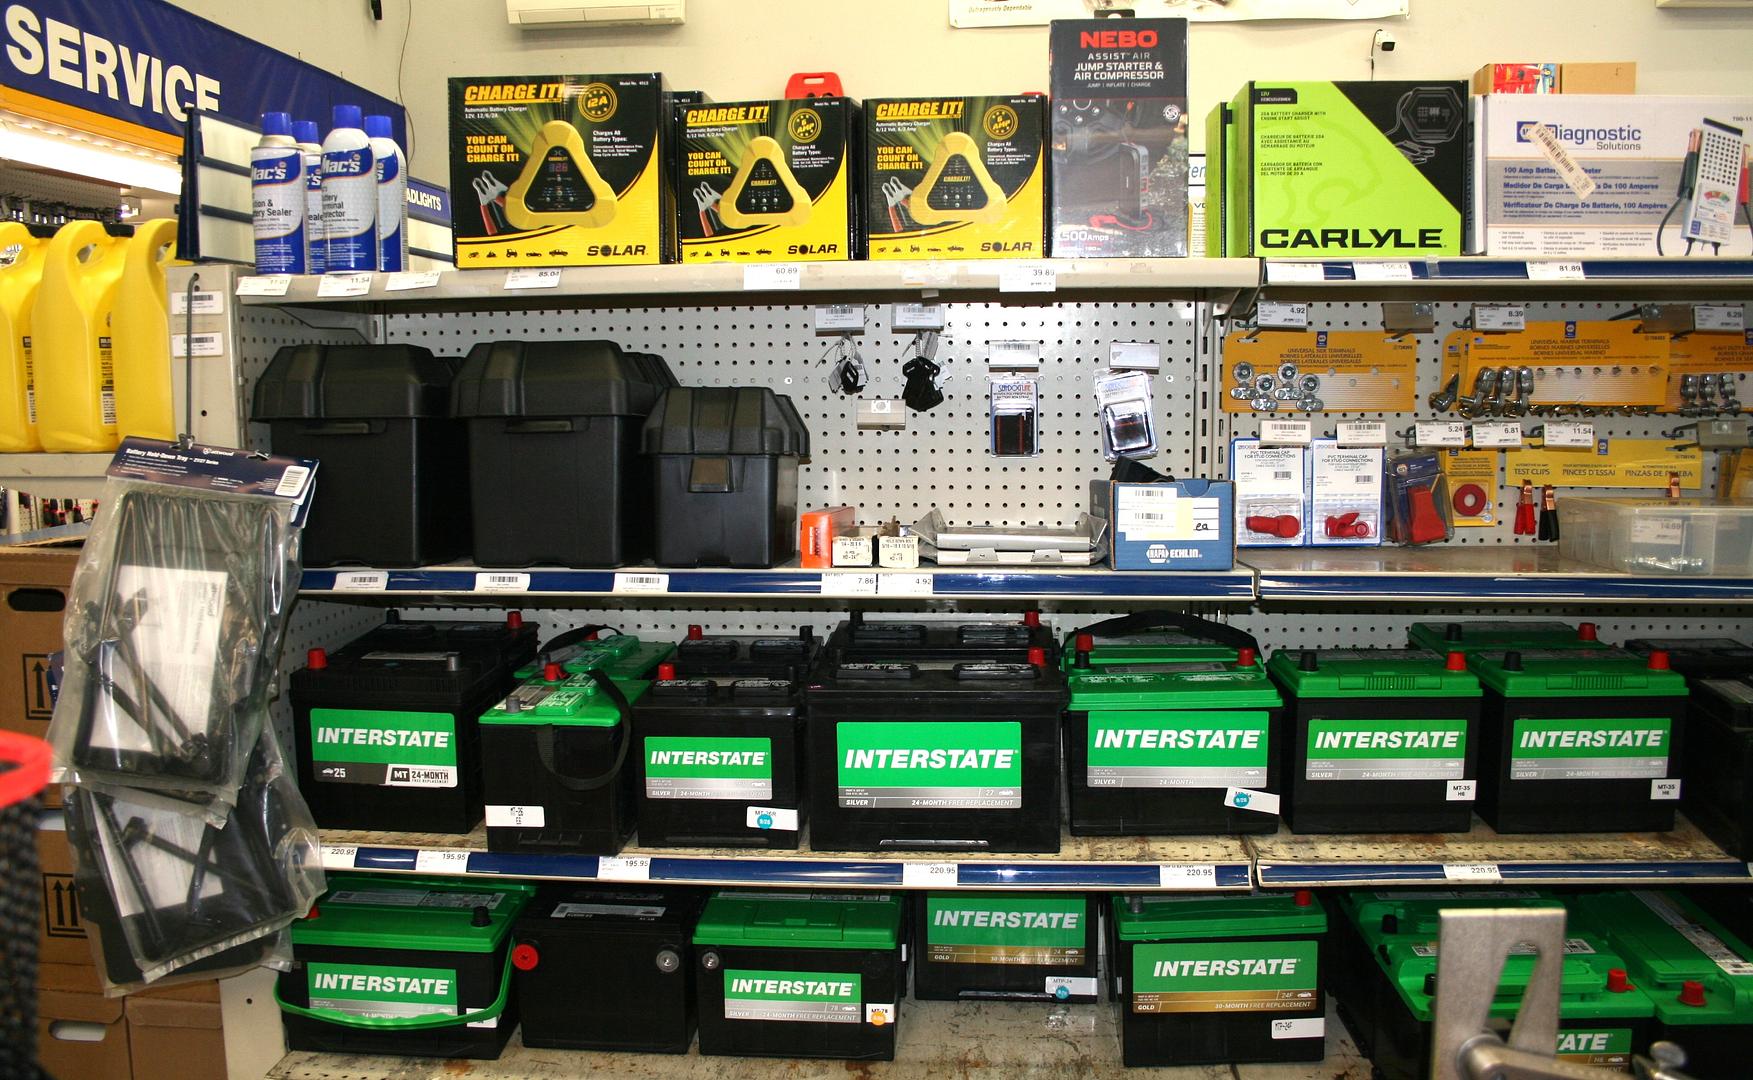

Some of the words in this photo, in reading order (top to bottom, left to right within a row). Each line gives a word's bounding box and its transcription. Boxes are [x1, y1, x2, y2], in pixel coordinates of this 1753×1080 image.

[1080, 29, 1158, 49] NEBO
[1132, 52, 1151, 60] AIR
[5, 4, 221, 123] SERVICE
[1075, 62, 1104, 72] JUMP
[1105, 61, 1153, 71] STARTER
[1154, 61, 1164, 71] &
[1073, 71, 1092, 81] AIR
[1093, 70, 1165, 80] COMPRESSOR
[464, 84, 538, 101] CHARGE
[540, 83, 566, 99] IT!
[687, 107, 747, 123] CHARGE
[748, 105, 770, 120] IT!
[876, 102, 940, 117] CHARGE
[941, 101, 964, 115] IT!
[465, 135, 486, 145] YOU
[487, 134, 507, 144] CAN
[466, 144, 499, 154] COUNT
[500, 144, 515, 153] ON
[877, 146, 894, 154] YOU
[895, 146, 913, 154] CAN
[1596, 142, 1642, 151] Solutions
[466, 153, 505, 163] CHARGE
[506, 153, 520, 163] IT!
[688, 152, 704, 160] YOU
[705, 151, 721, 159] CAN
[877, 154, 906, 162] COUNT
[906, 154, 919, 162] ON
[688, 159, 715, 168] COUNT
[715, 159, 727, 167] ON
[877, 162, 911, 170] CHARGE
[911, 162, 923, 170] IT!
[688, 168, 720, 176] CHARGE
[720, 166, 731, 175] IT!
[1518, 167, 1534, 175] Amp
[1503, 182, 1530, 190] Medidor
[1532, 182, 1542, 190] De
[1545, 182, 1564, 191] Carga
[1630, 182, 1659, 191] Amperes
[267, 199, 274, 207] &
[1555, 202, 1579, 211] Charge
[267, 208, 293, 217] Sealer
[1260, 229, 1443, 249] CARLYLE
[586, 244, 649, 258] SOLAR
[787, 244, 838, 255] SOLAR
[980, 241, 1032, 252] SOLAR
[1448, 425, 1464, 433] 5.24
[1573, 427, 1593, 435] 11.54
[1562, 469, 1588, 477] PINCES
[1625, 470, 1651, 478] PINZAS
[1195, 522, 1210, 531] ea
[1169, 548, 1199, 559] ECHLIN
[316, 727, 450, 748] INTERSTATE
[1094, 729, 1261, 749] INTERSTATE
[1315, 731, 1460, 749] INTERSTATE
[1519, 730, 1664, 748] INTERSTATE
[650, 750, 765, 766] INTERSTATE
[845, 749, 1014, 769] INTERSTATE
[333, 768, 346, 778] 25
[393, 770, 408, 779] MT
[411, 771, 449, 780] 24-MONTH
[330, 848, 355, 856] 220.95
[442, 853, 466, 861] 195.95
[929, 866, 956, 874] 220.95
[934, 910, 1079, 929] INTERSTATE
[1153, 958, 1297, 977] INTERSTATE
[314, 973, 450, 996] INTERSTATE
[731, 978, 853, 996] INTERSTATE
[1265, 1001, 1311, 1009] REPLACEMENT
[810, 1013, 856, 1021] REPLACEMENT
